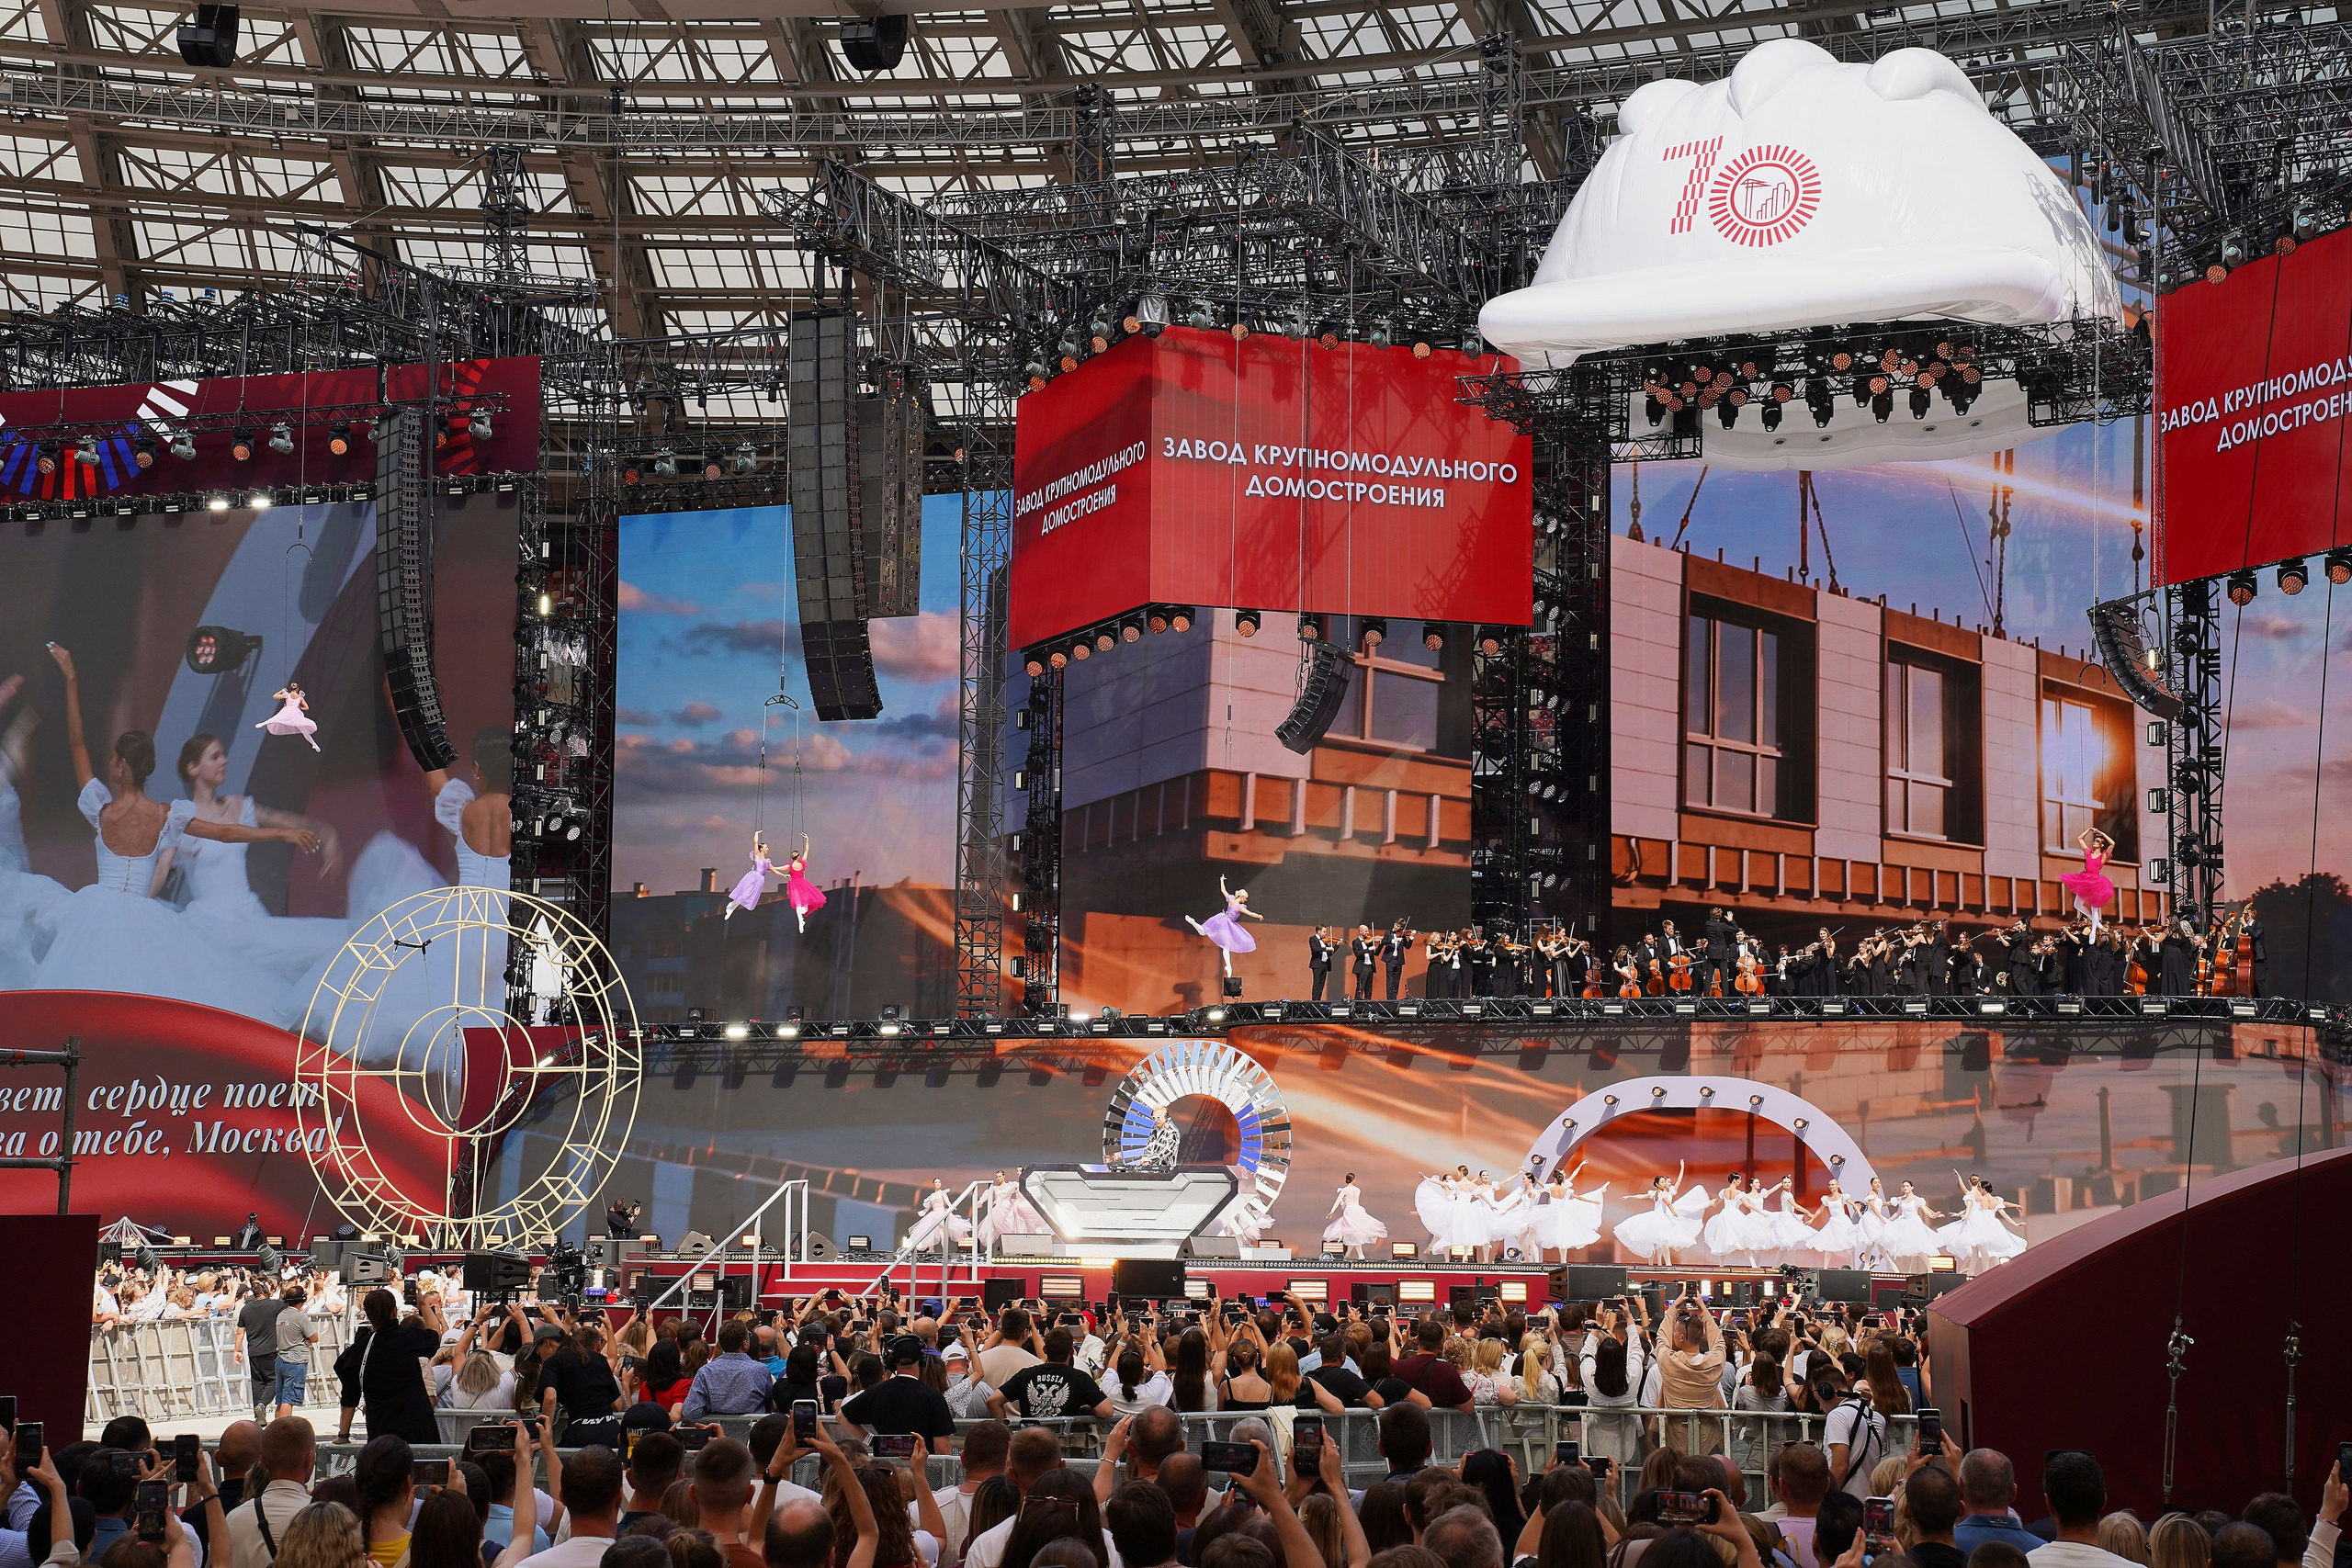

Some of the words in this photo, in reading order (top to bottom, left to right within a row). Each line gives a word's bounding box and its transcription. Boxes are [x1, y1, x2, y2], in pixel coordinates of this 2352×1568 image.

[2160, 397, 2220, 434] ЗАВОД
[1015, 488, 1044, 518] ЗАВОД
[1045, 440, 1146, 504] КРУПНОМОДУЛЬНОГО
[1162, 436, 1248, 466] ЗАВОД
[1254, 444, 1518, 484] КРУПНОМОДУЛЬНОГО
[1041, 483, 1116, 536] ДОМОСТРОЕНИЯ
[1245, 474, 1445, 508] ДОМОСТРОЕНИЯ
[87, 1074, 212, 1118] сердце
[222, 1081, 320, 1109] поет
[39, 1130, 60, 1156] о
[72, 1119, 171, 1160] тебе,
[1036, 1373, 1064, 1384] RUSSIA
